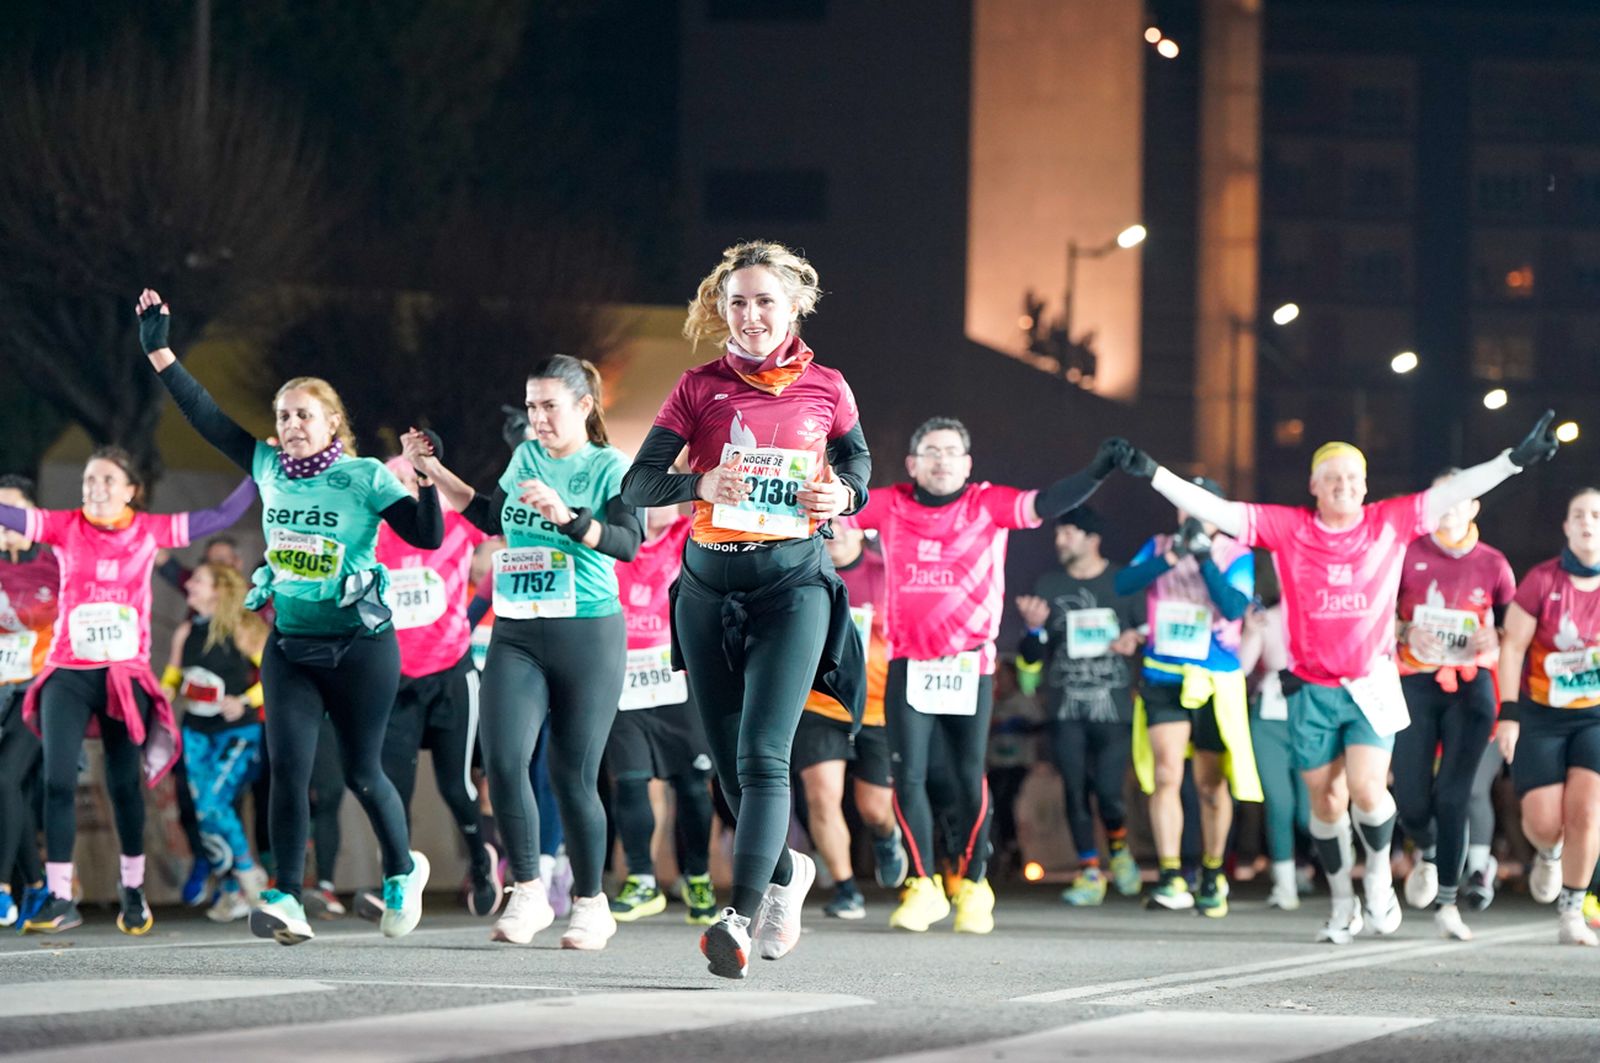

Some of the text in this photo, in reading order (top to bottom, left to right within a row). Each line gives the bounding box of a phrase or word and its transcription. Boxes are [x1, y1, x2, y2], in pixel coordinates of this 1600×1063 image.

[743, 456, 784, 467] NOCHE DE
[744, 476, 798, 507] 2138
[266, 505, 339, 528] serás
[504, 506, 570, 535] ser
[511, 571, 556, 594] 7752
[396, 590, 429, 607] 7381
[87, 625, 122, 642] 3115
[629, 668, 671, 687] 2896
[924, 674, 963, 691] 2140
